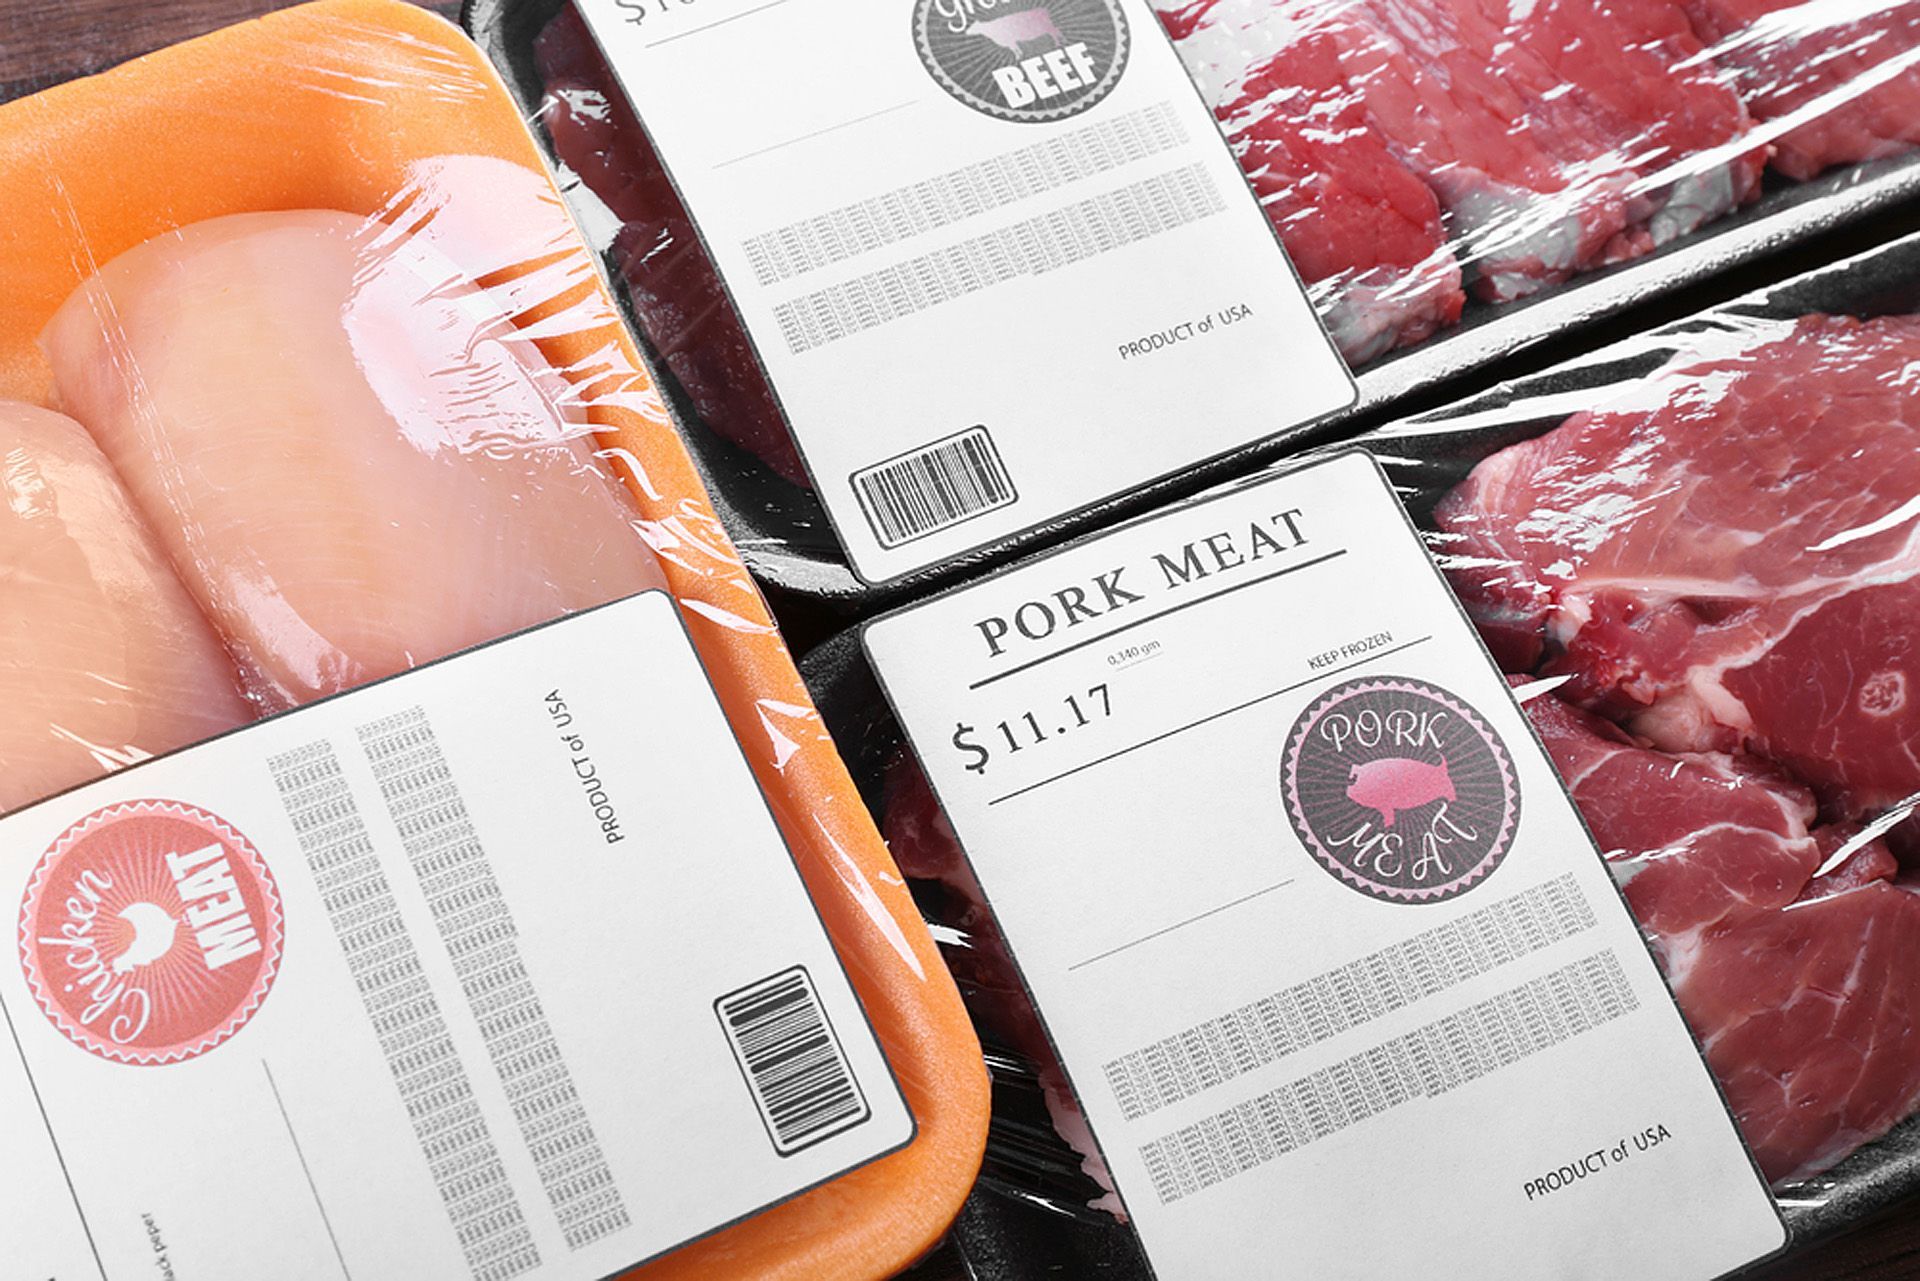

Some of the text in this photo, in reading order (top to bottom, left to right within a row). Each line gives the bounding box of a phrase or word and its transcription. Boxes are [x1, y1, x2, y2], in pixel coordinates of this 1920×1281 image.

[992, 42, 1097, 109] BEEF
[1118, 303, 1253, 360] PRODUCT of USA
[974, 508, 1310, 658] PORK MEAT
[1307, 631, 1394, 670] KEEP FROZEN
[544, 689, 626, 844] PRODUCT of USA
[1320, 709, 1449, 752] PORK
[1327, 802, 1478, 881] MEAT
[164, 842, 262, 971] MEAT
[37, 869, 150, 1044] Chicken
[1524, 1124, 1672, 1201] PRODUCT of USA
